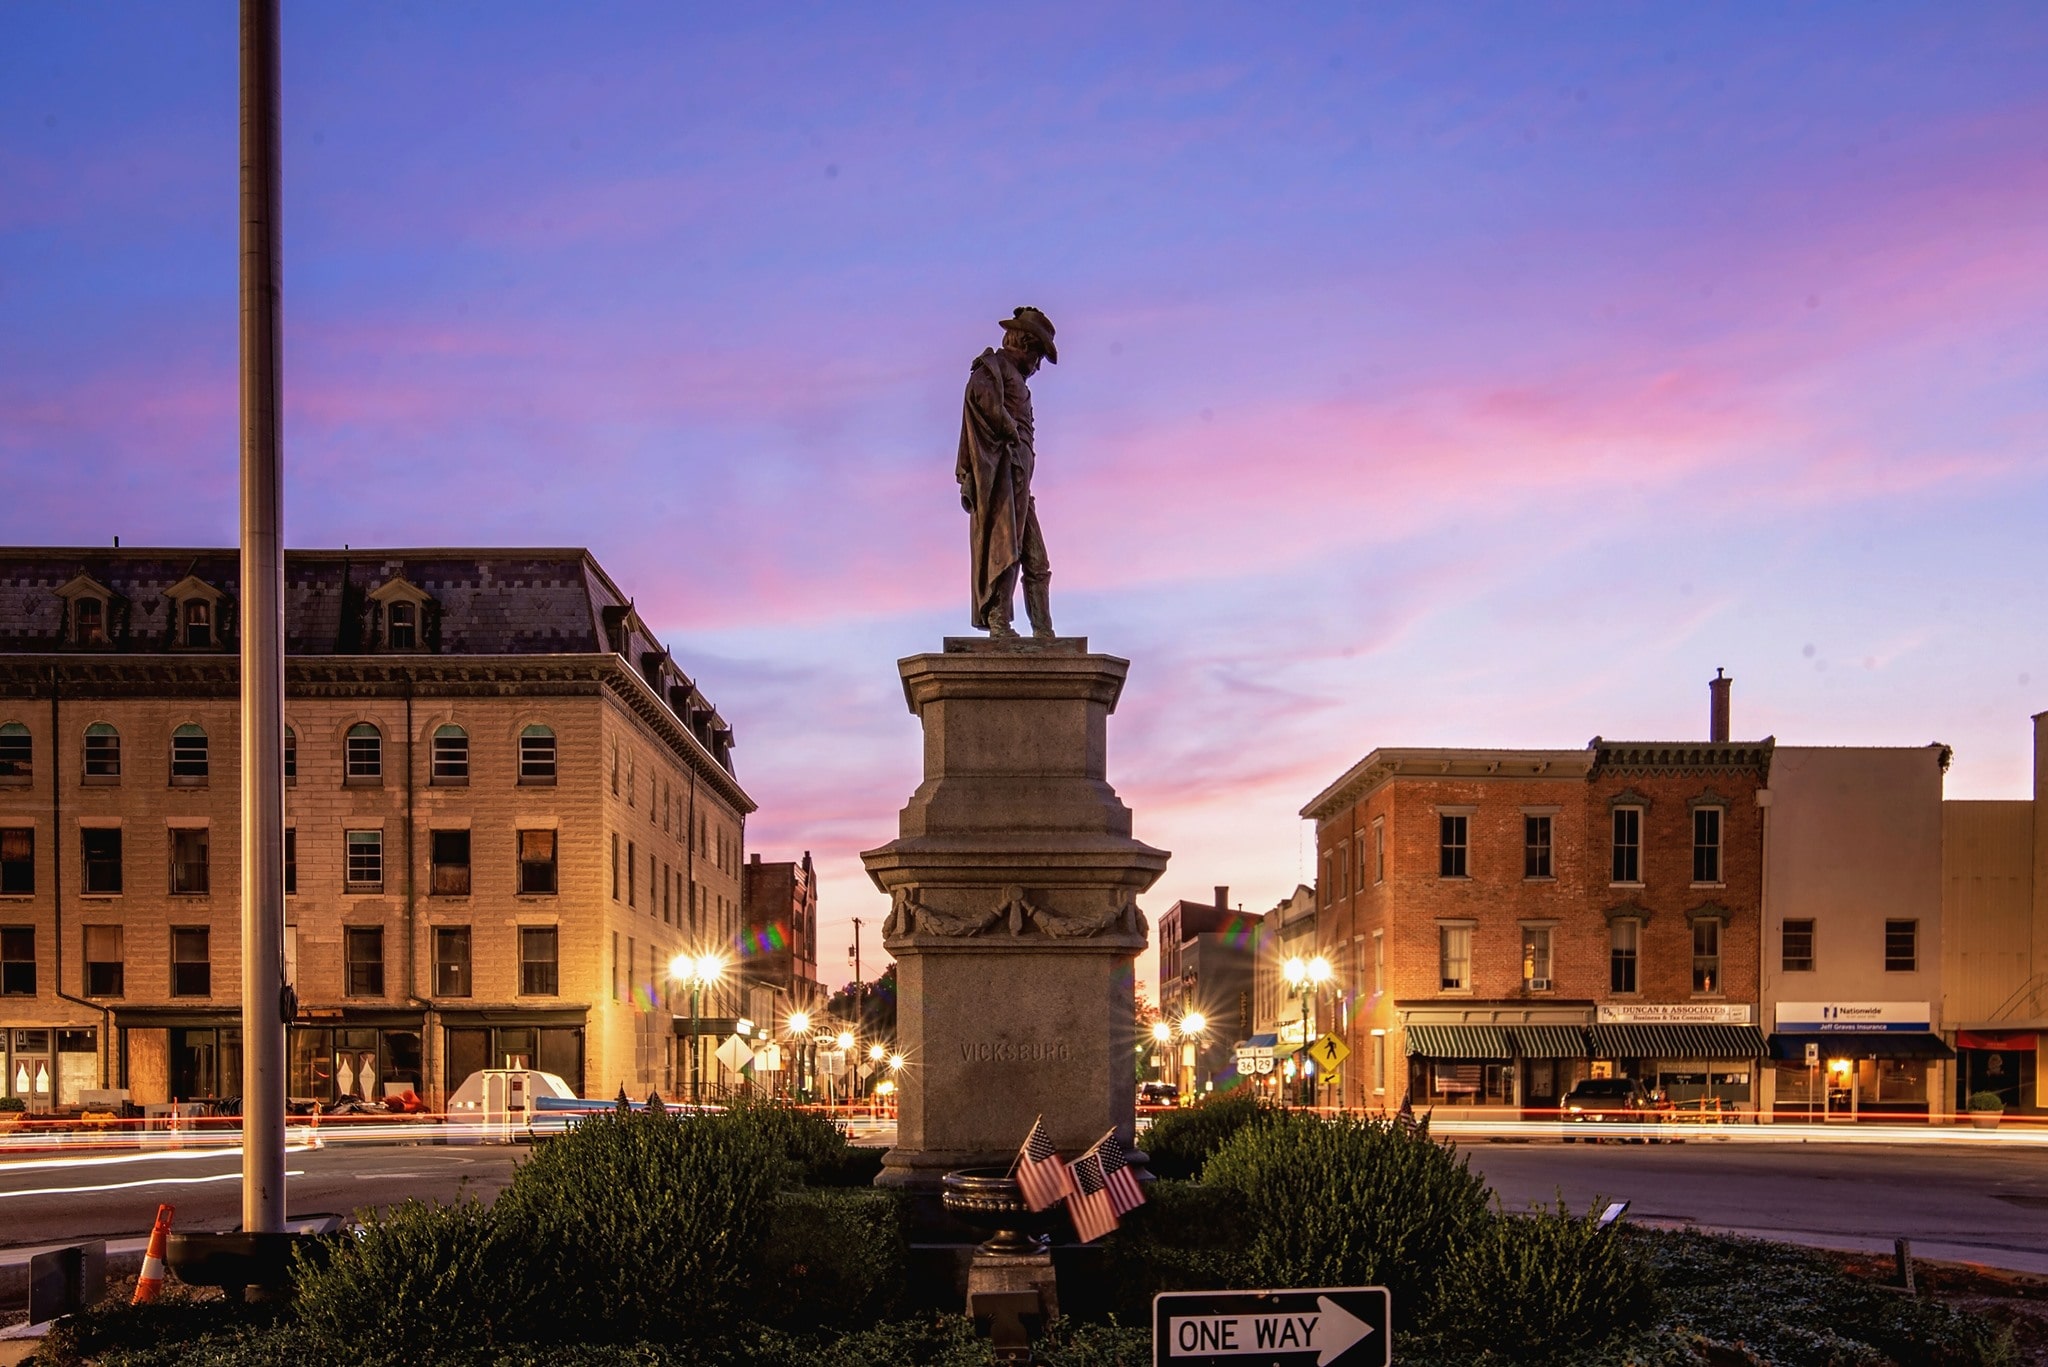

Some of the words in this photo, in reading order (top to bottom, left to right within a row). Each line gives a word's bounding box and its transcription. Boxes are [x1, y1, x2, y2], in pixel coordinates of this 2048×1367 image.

[1622, 1006, 1660, 1014] DUNCAN
[1662, 1006, 1668, 1014] &
[1670, 1006, 1726, 1014] ASSOCIATES
[1240, 1061, 1253, 1071] 36
[1258, 1060, 1271, 1070] 29
[1179, 1320, 1239, 1352] ONE
[1255, 1317, 1319, 1349] WAY
